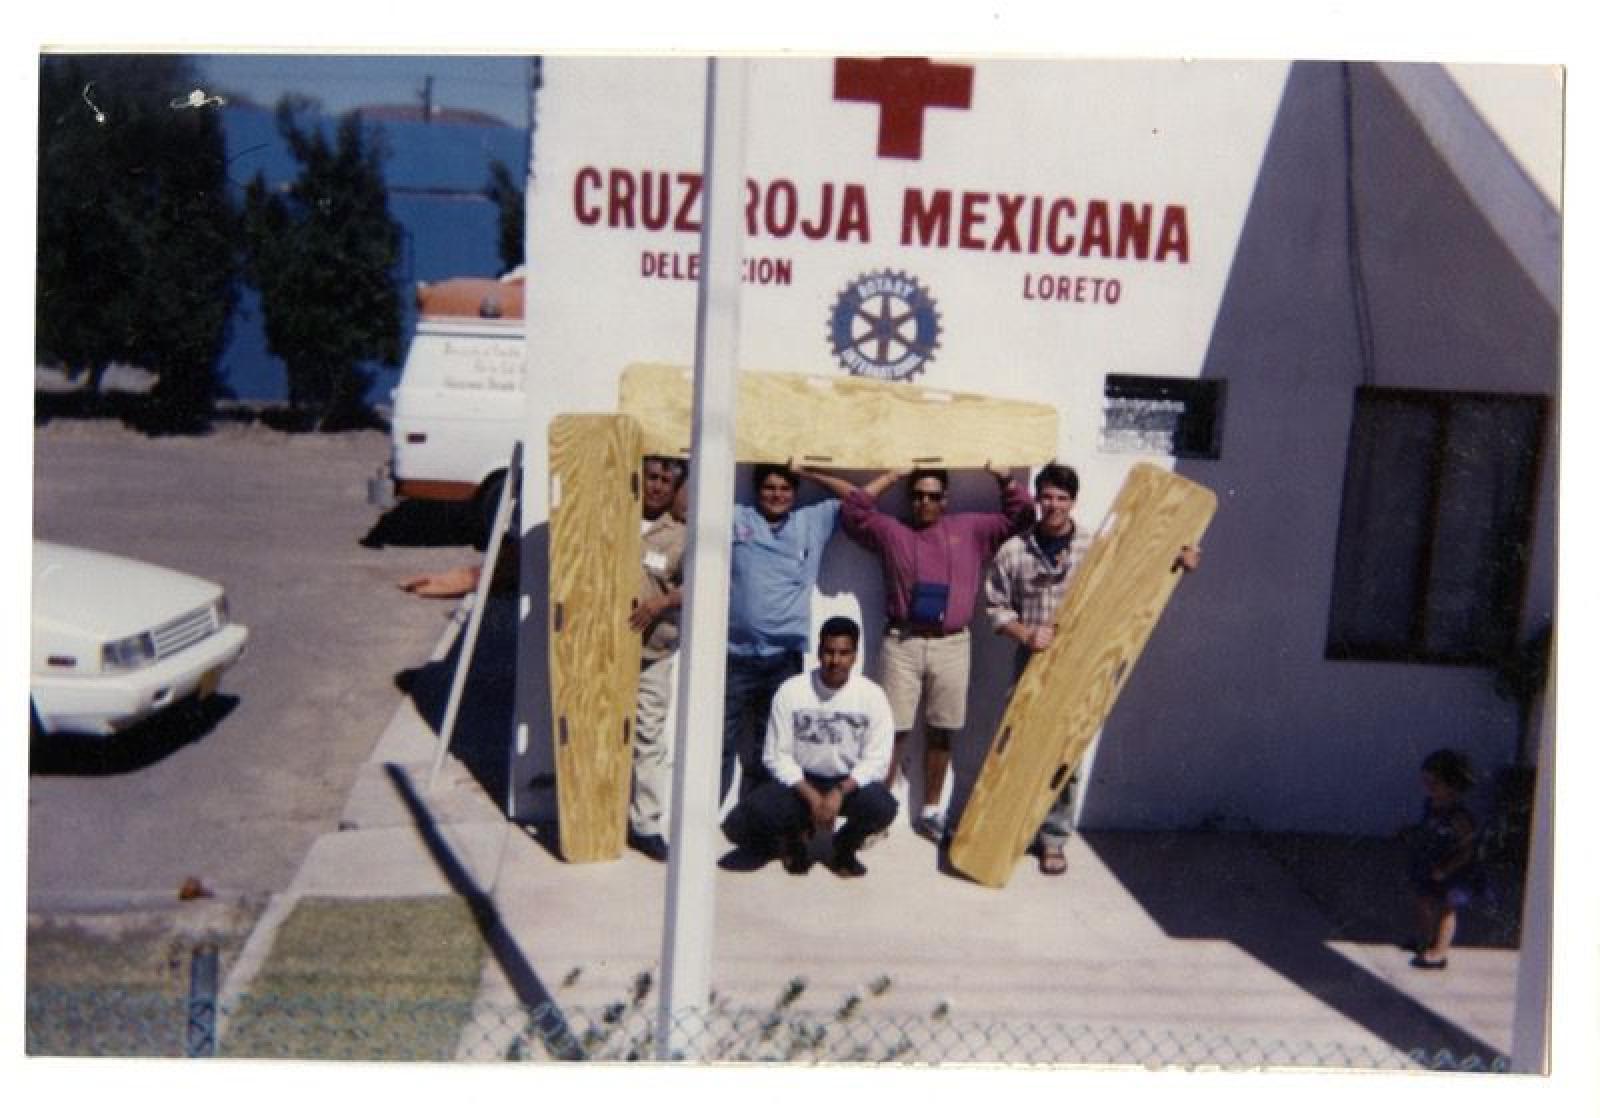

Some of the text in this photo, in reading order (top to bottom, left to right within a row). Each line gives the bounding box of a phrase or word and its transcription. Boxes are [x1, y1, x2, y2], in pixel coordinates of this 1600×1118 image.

[573, 166, 703, 232] CRUZ
[900, 187, 1190, 263] MEXICANA
[641, 251, 792, 285] DELEION
[1022, 273, 1121, 304] LORETO
